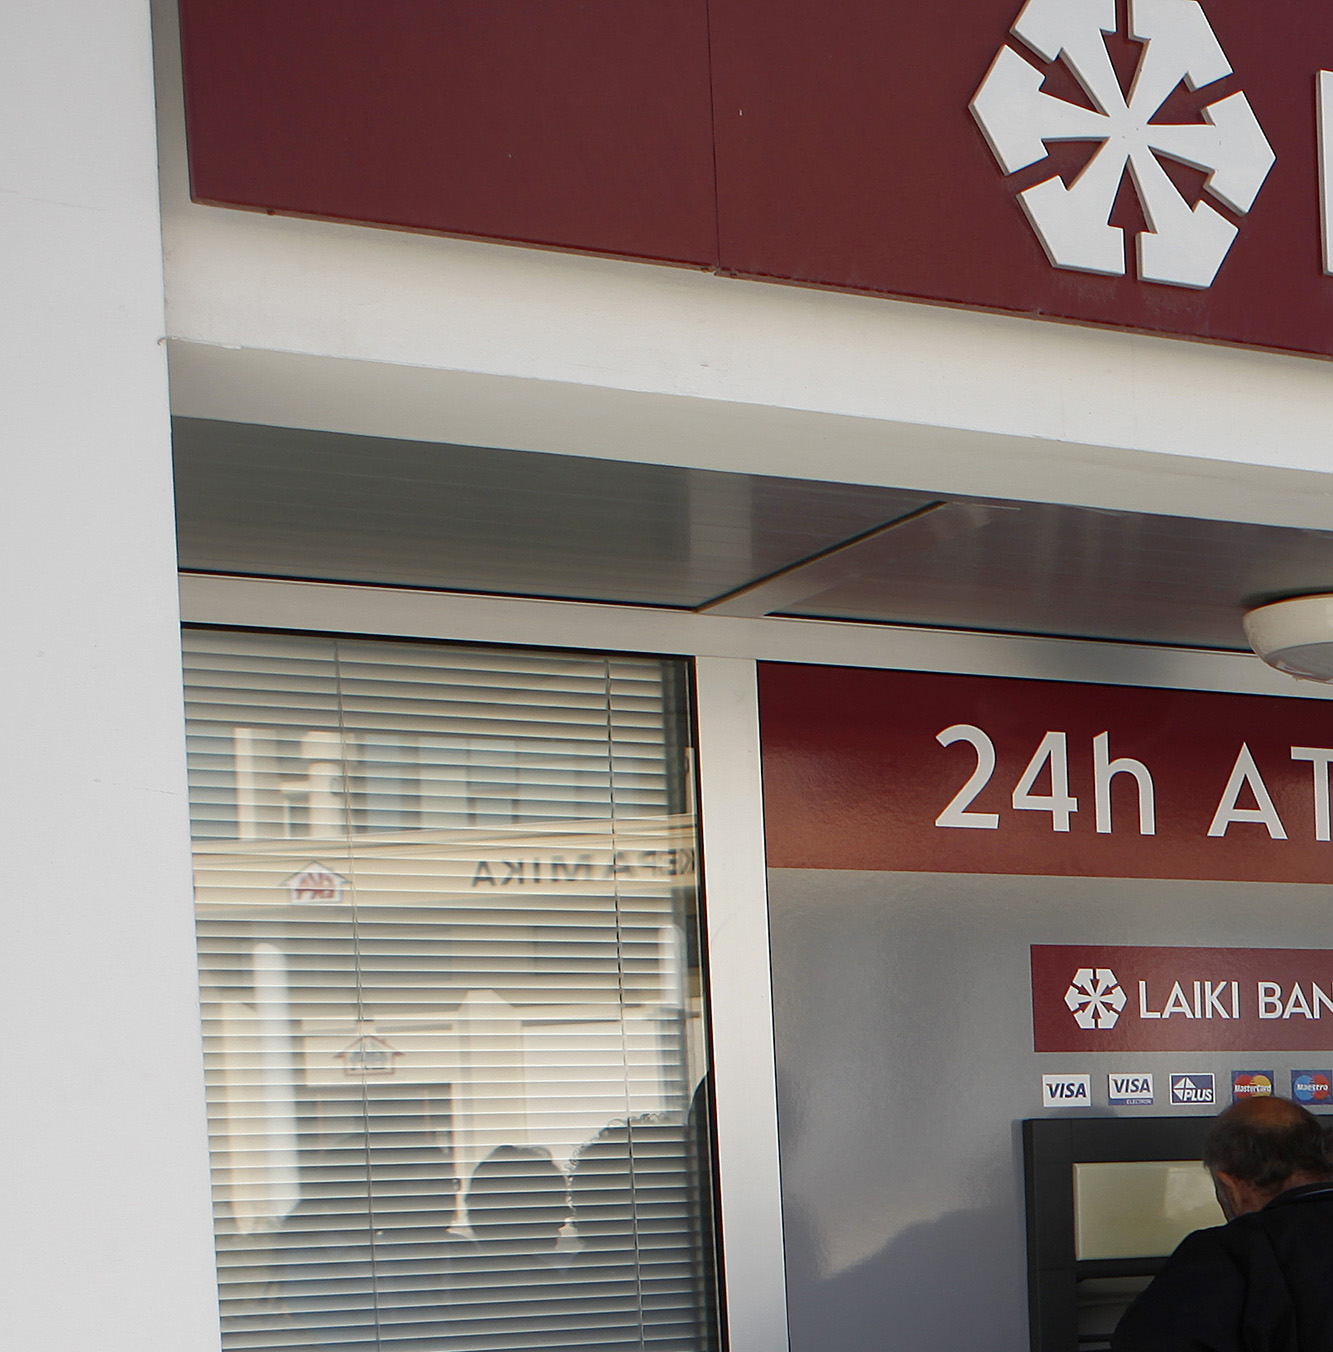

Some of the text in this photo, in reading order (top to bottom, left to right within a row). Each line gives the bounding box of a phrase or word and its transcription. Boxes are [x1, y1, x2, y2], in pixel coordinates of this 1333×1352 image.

[934, 723, 1156, 836] 24h
[1138, 980, 1240, 1019] LAIKI
[1046, 1082, 1088, 1099] VISA
[1111, 1077, 1151, 1094] VISA
[1234, 1083, 1272, 1094] MasterCard
[1296, 1083, 1329, 1092] Maestro
[1183, 1088, 1213, 1102] PLUS
